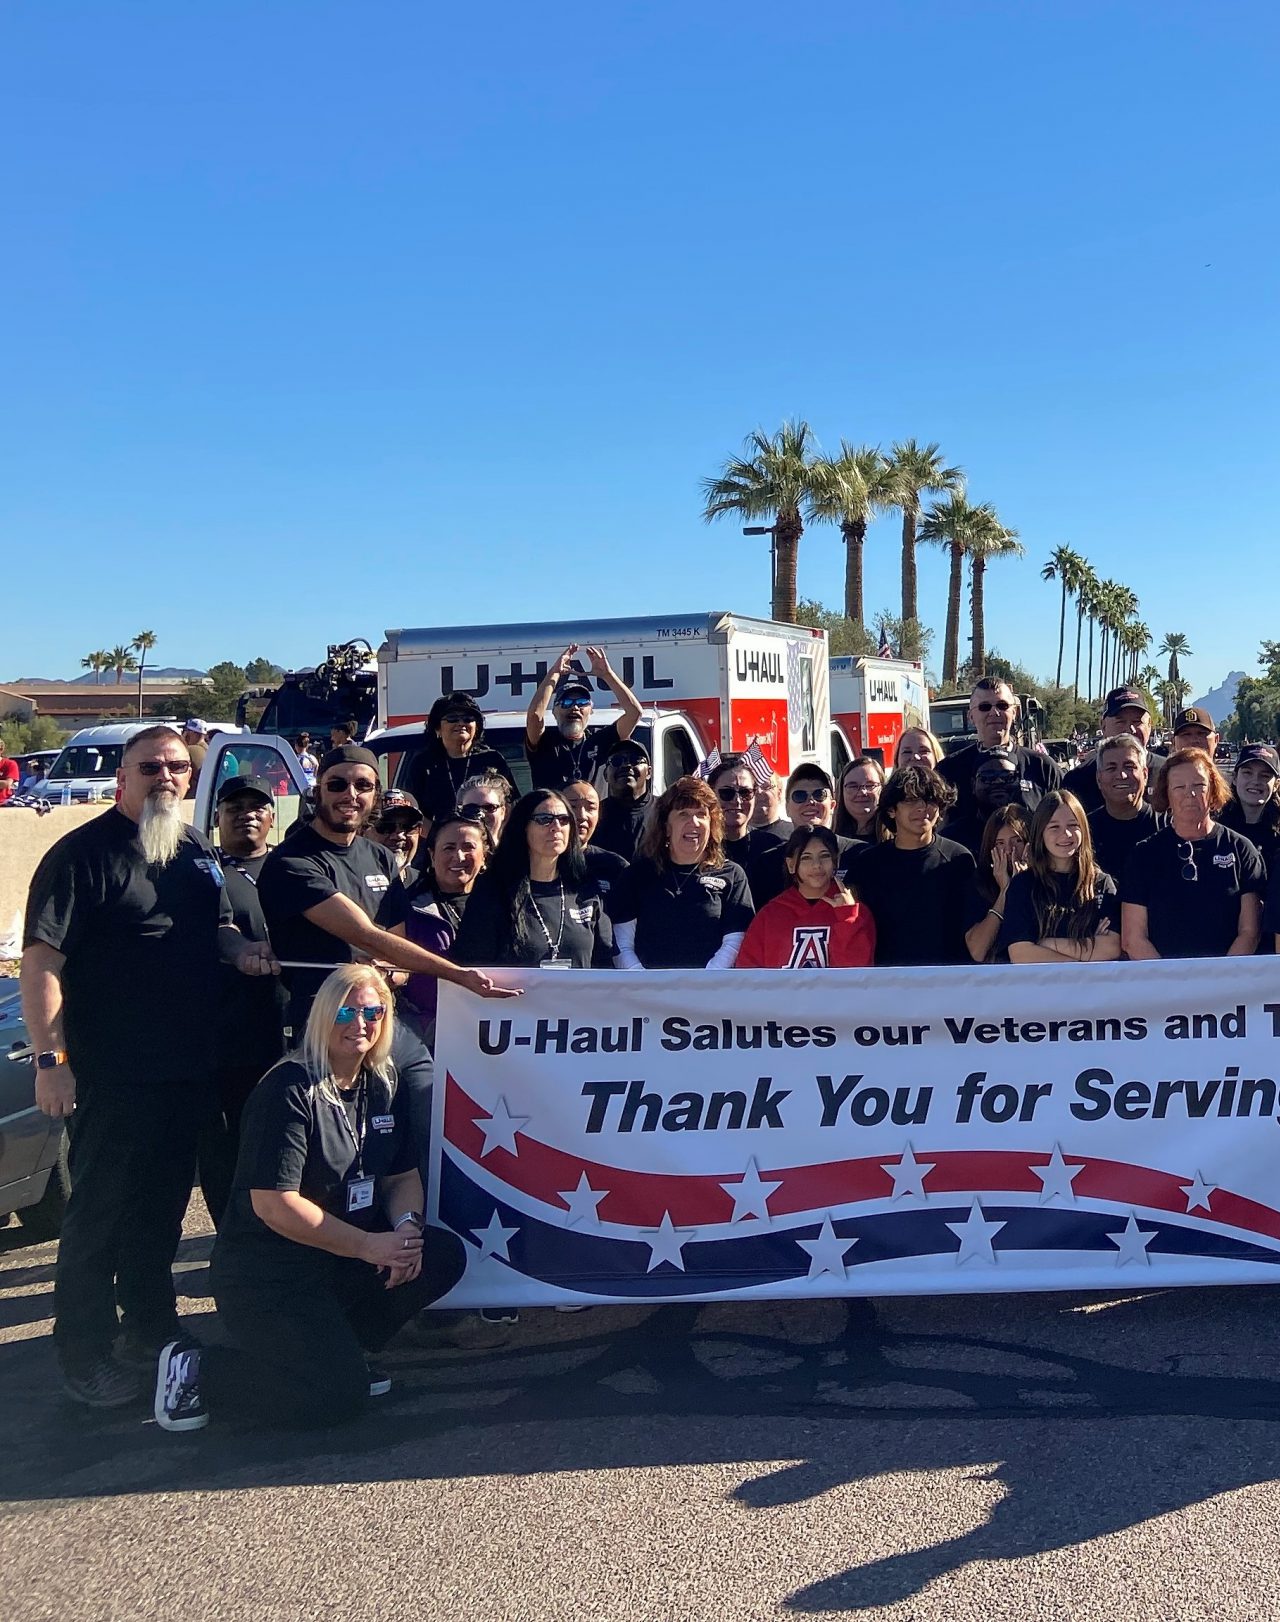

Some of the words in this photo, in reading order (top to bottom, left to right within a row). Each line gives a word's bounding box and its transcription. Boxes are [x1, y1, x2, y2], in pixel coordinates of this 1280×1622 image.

[656, 629, 670, 637] TM
[672, 628, 692, 637] 3445
[693, 627, 701, 635] K
[736, 649, 784, 683] U-HAUL
[869, 679, 898, 702] U-HAUL
[660, 1017, 836, 1051] Salutes
[854, 1026, 931, 1047] our
[944, 1016, 1148, 1044] Veterans
[1165, 1005, 1246, 1040] and
[581, 1078, 792, 1133] Thank
[816, 1074, 933, 1128] You
[956, 1071, 1053, 1124] for
